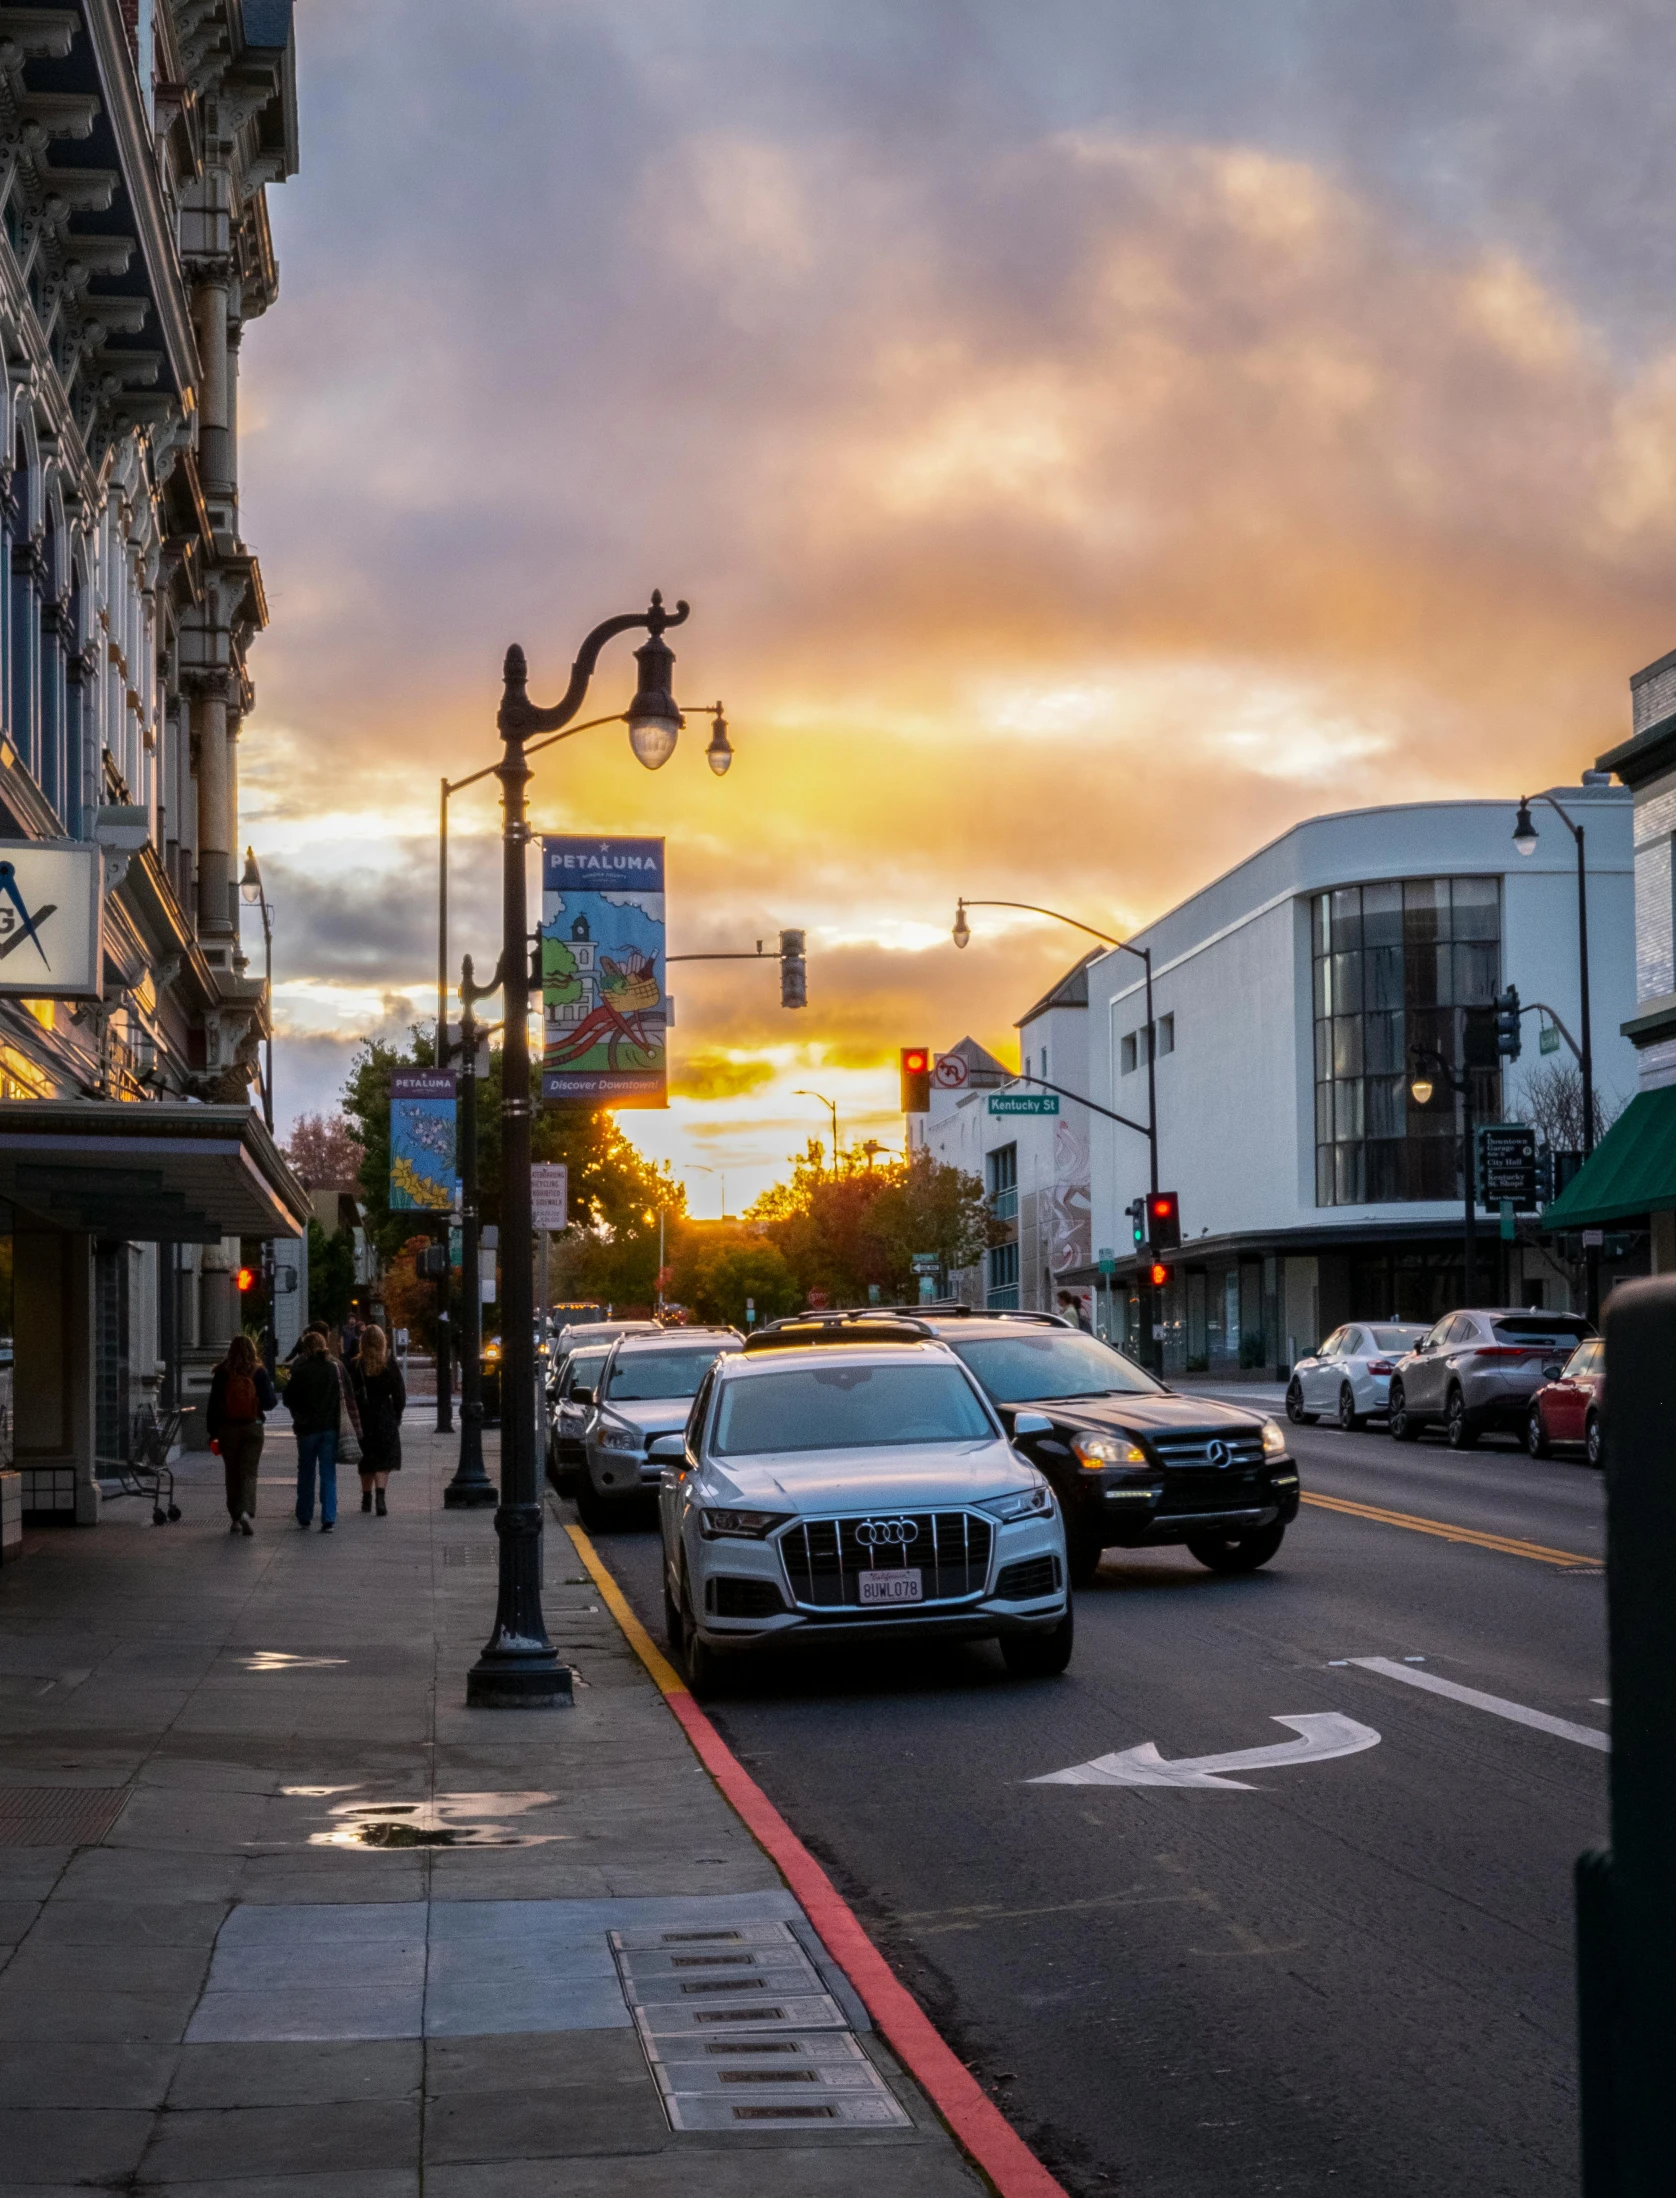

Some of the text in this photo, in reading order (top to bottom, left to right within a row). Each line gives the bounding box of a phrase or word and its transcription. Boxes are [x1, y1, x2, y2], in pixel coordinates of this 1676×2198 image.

[551, 854, 657, 871] PETALUMA
[0, 907, 15, 934] G
[551, 1080, 659, 1090] Discover Downtown!
[991, 1099, 1055, 1112] Kentucky St
[1488, 1173, 1525, 1181] Kentucky
[863, 1581, 918, 1598] 8UWL078
